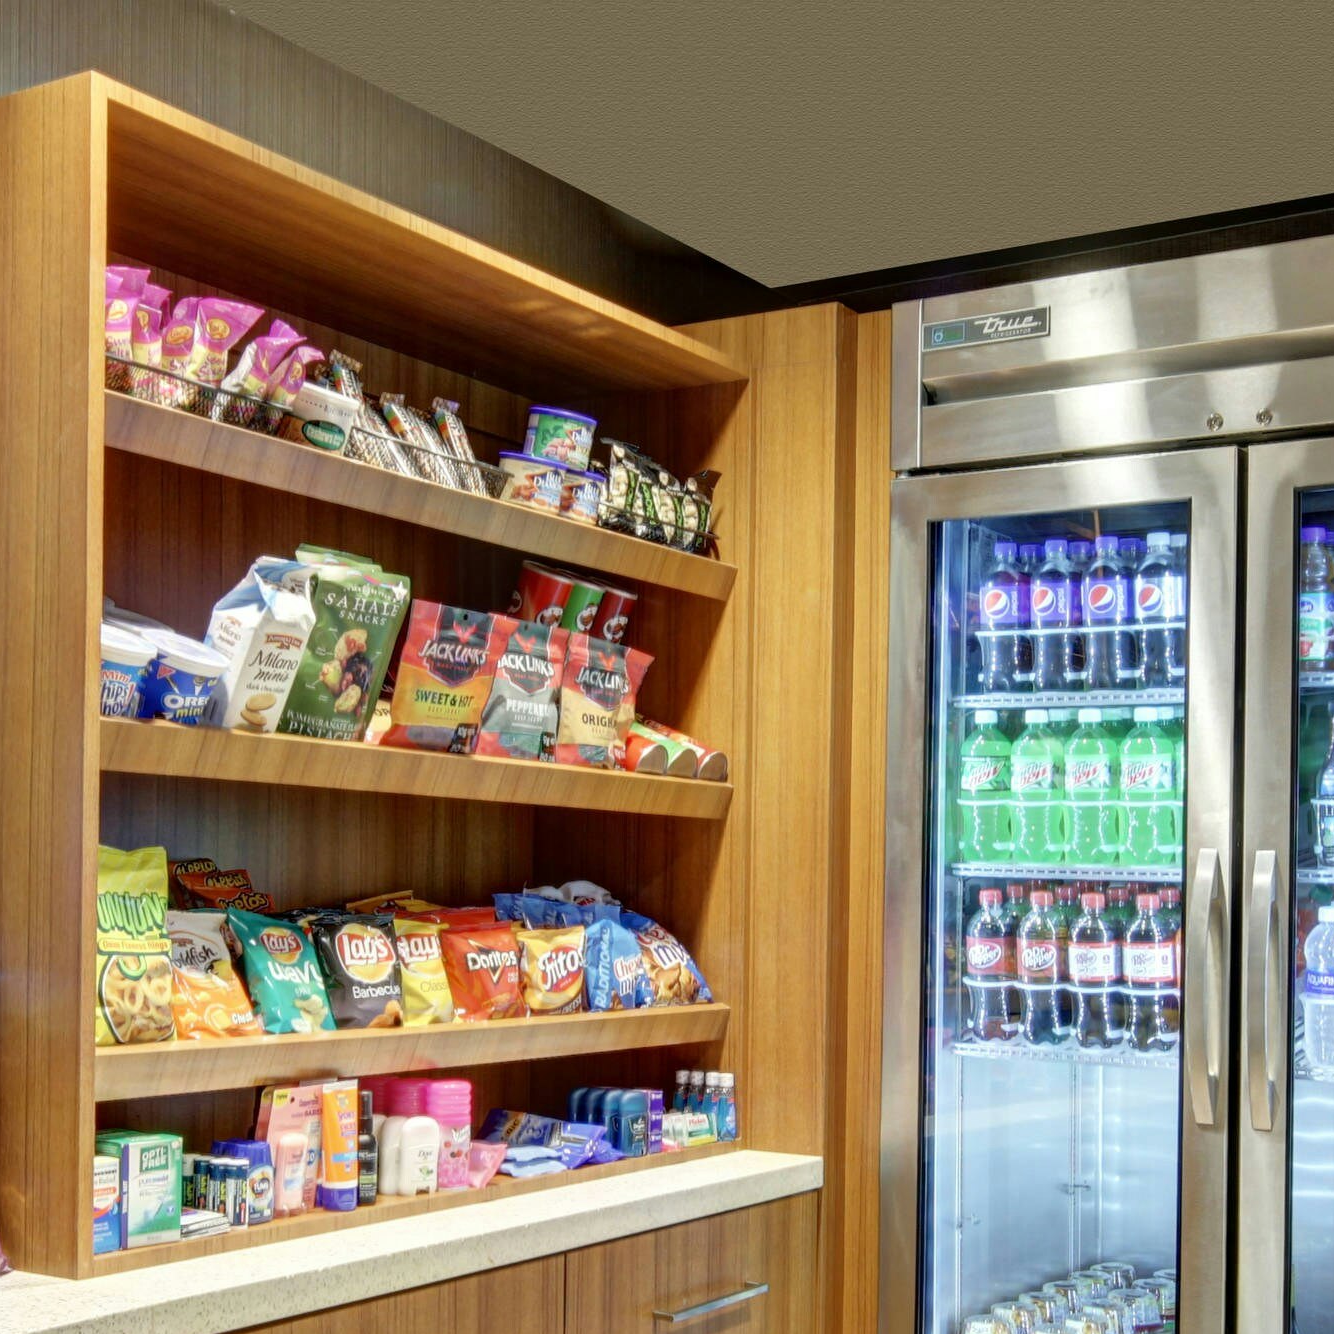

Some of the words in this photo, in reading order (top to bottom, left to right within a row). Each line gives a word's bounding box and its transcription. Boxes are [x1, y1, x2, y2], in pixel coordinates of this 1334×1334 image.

[324, 592, 400, 618] SAHALE
[1058, 587, 1066, 614] pepsi
[339, 610, 387, 626] SNACKS
[248, 650, 298, 672] Milano
[419, 640, 454, 662] JACK
[254, 669, 290, 684] minis
[576, 667, 605, 688] JACK
[415, 689, 448, 706] SWEET
[449, 696, 456, 706] &
[344, 934, 393, 966] Lay's
[467, 950, 518, 972] Doritos
[352, 985, 401, 999] Barbecue
